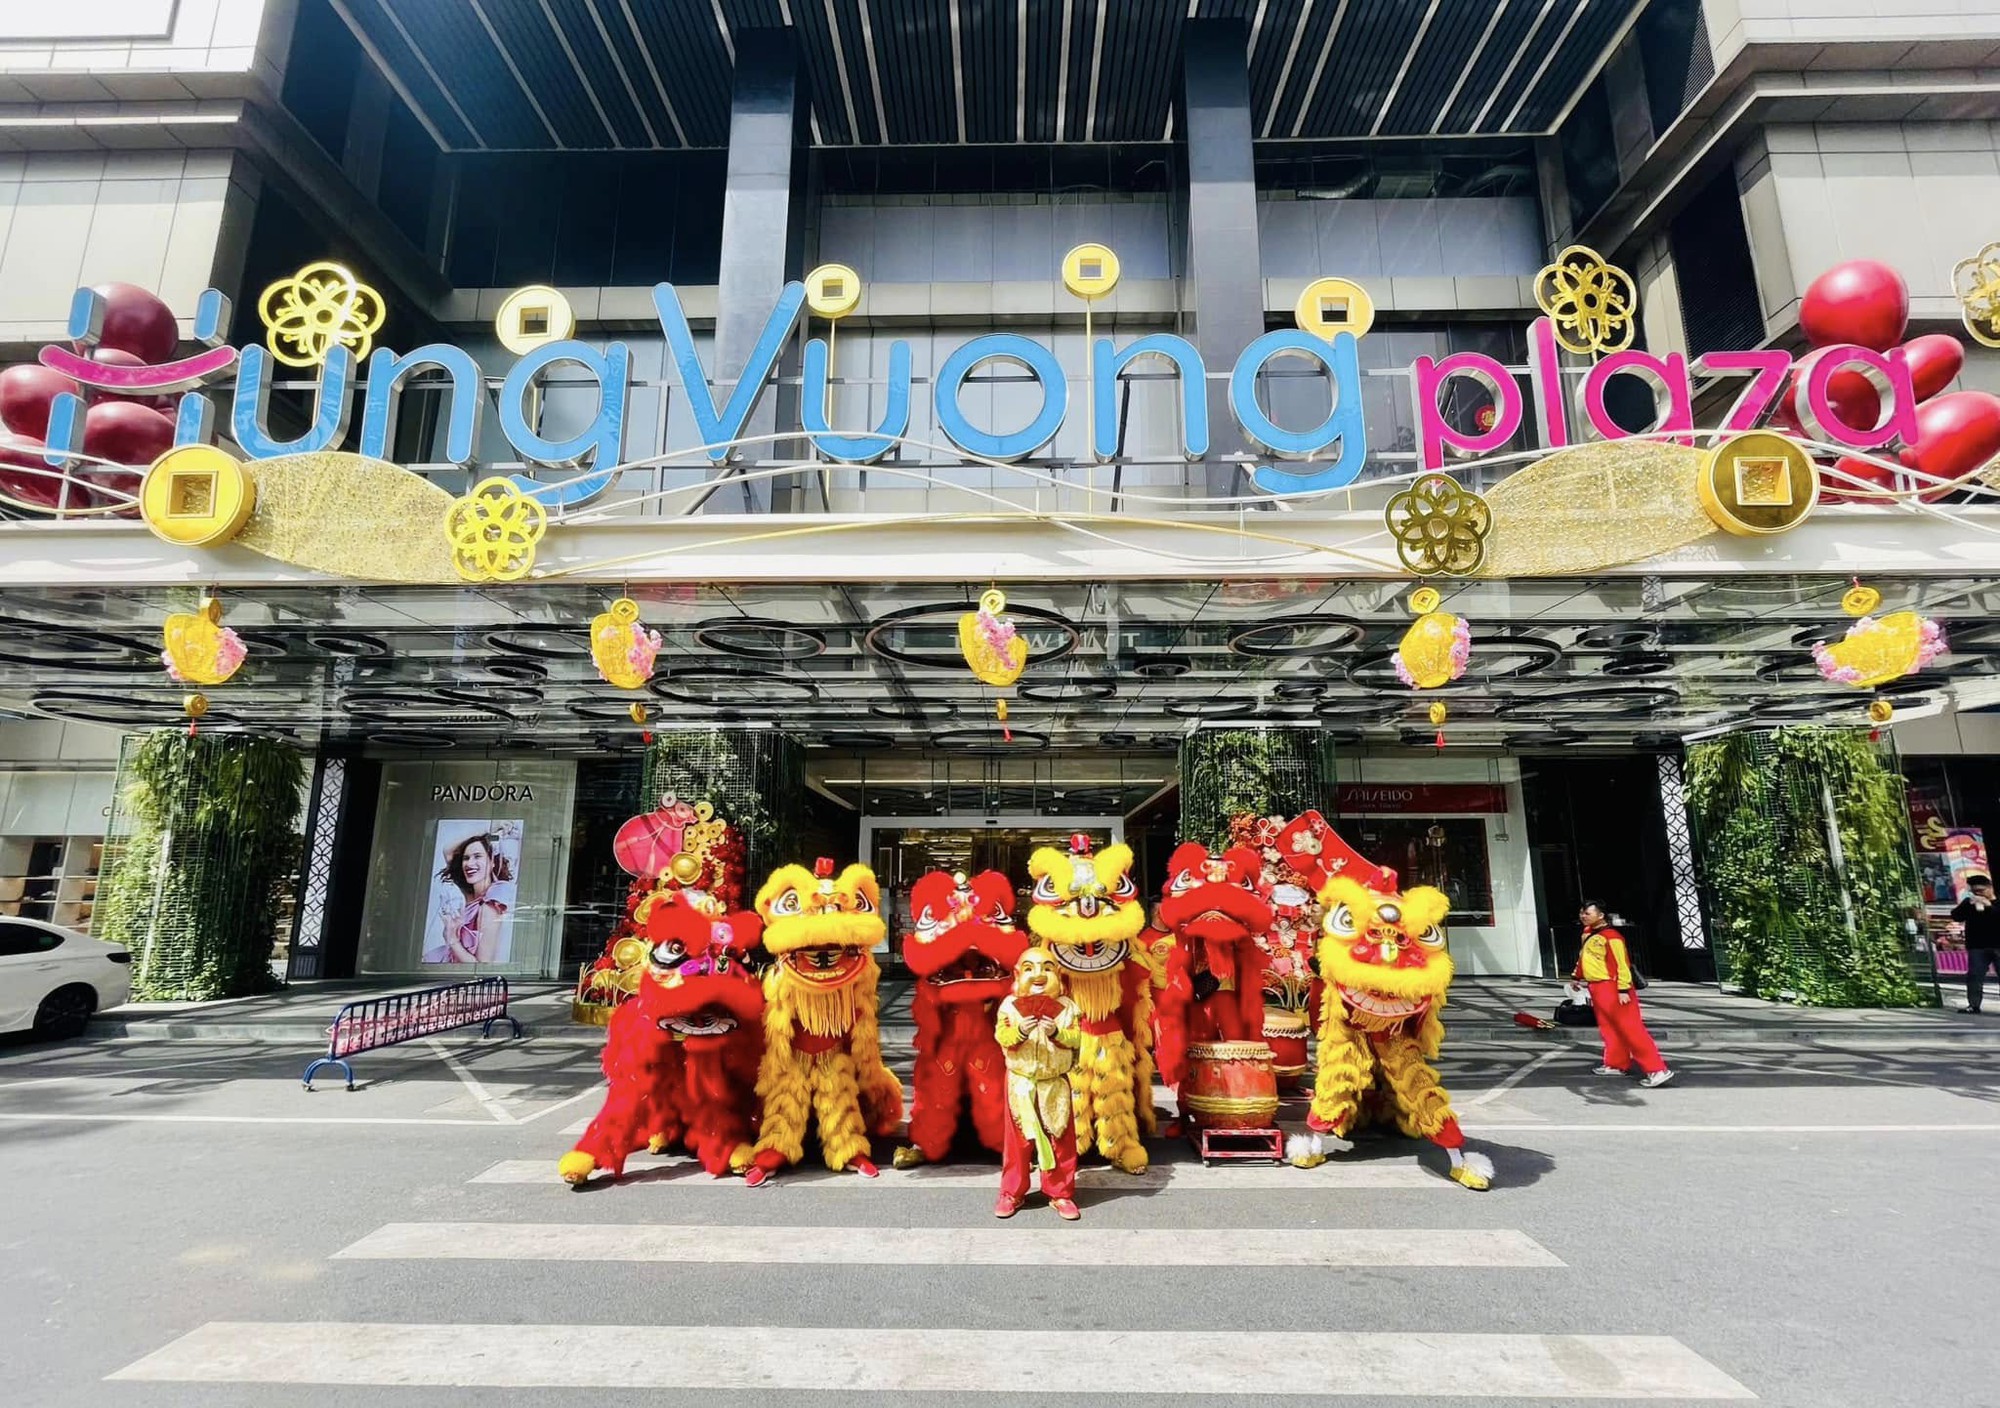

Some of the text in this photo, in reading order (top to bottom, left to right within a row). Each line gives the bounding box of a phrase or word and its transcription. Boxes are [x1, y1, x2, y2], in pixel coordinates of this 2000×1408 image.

[1415, 316, 1919, 482] plaza
[431, 784, 533, 802] PANDORA
[1343, 788, 1413, 802] SHISEIDO
